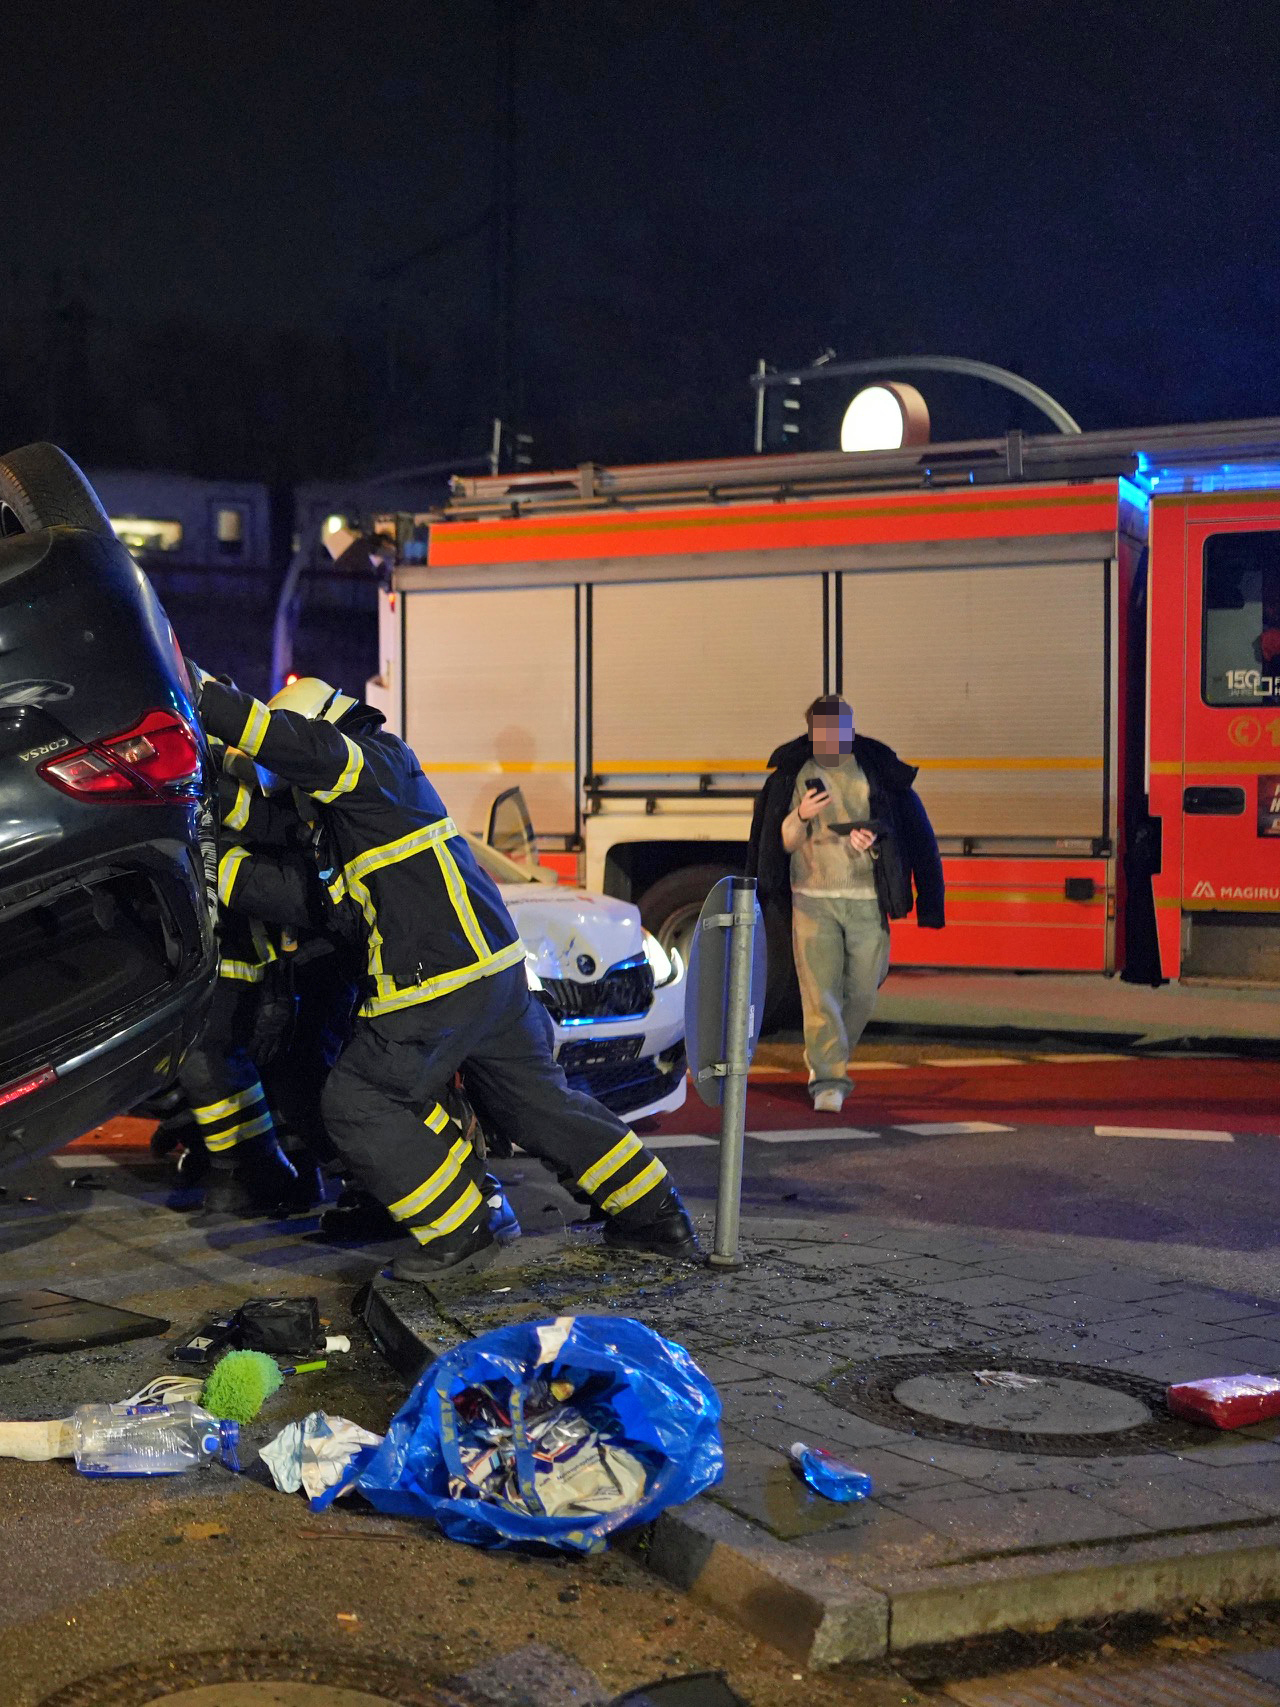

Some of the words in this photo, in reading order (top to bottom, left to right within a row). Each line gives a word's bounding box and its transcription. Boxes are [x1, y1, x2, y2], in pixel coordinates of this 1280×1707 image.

[1225, 669, 1260, 690] 150
[19, 738, 69, 761] CORSA
[1220, 886, 1280, 899] MAGIRU
